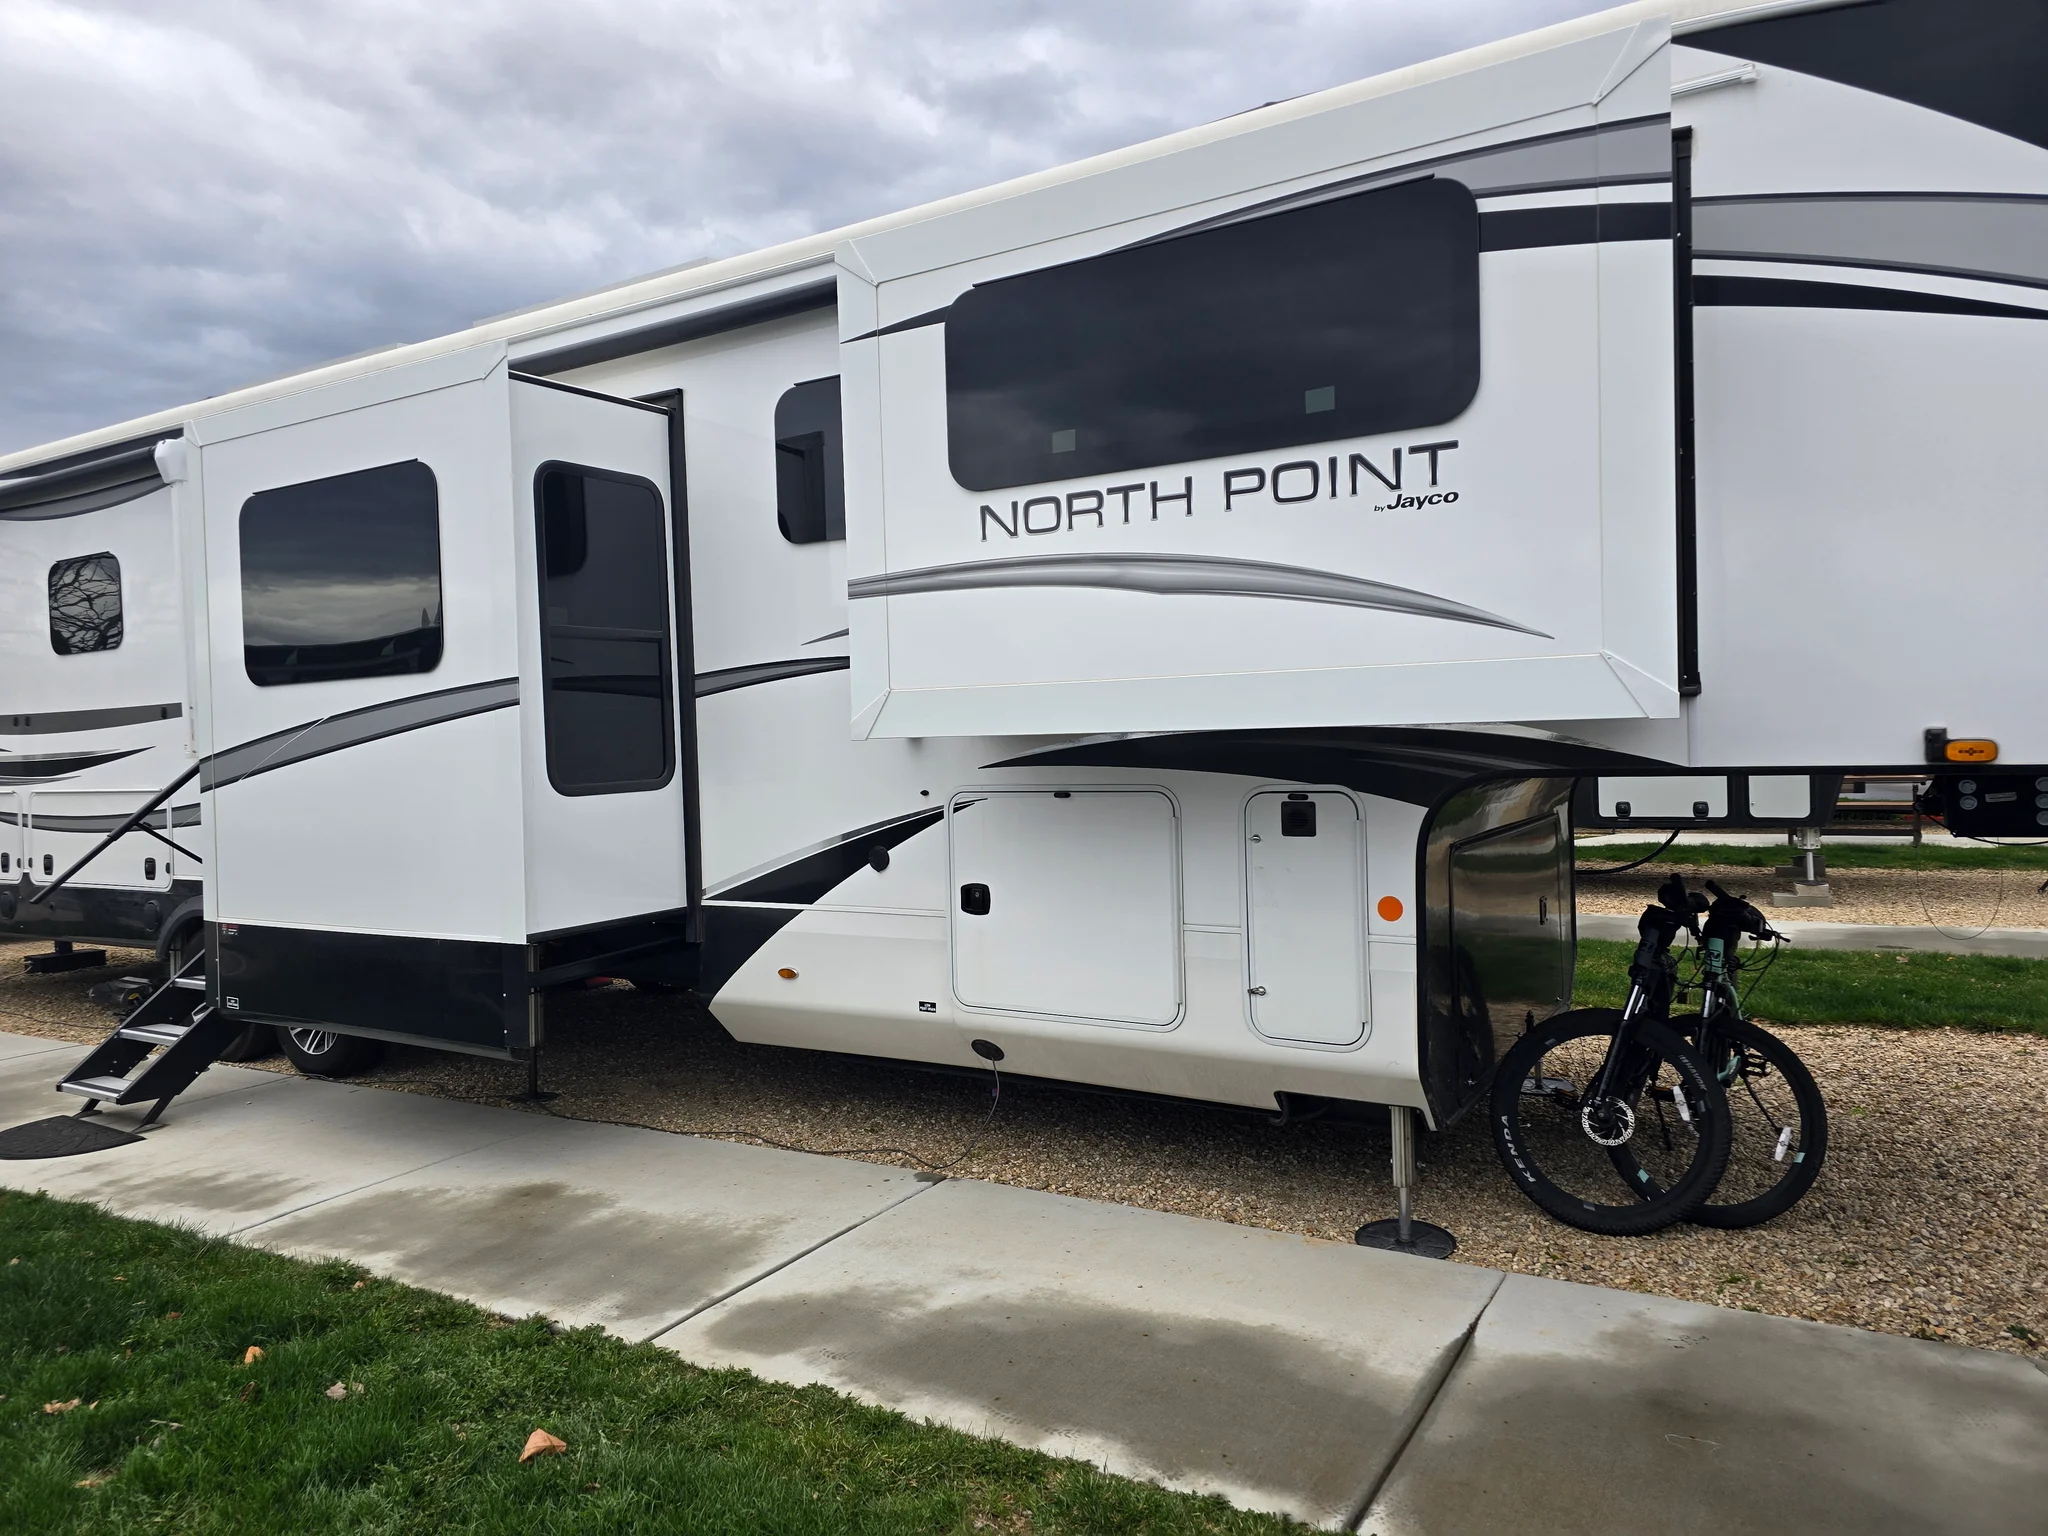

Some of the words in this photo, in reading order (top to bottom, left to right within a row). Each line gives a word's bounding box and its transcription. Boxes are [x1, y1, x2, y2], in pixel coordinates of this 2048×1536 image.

[979, 475, 1194, 543] NORTH
[1223, 439, 1459, 513] POINT
[1374, 504, 1386, 512] by
[1387, 491, 1459, 511] Jayco
[1501, 1115, 1537, 1183] KENDA
